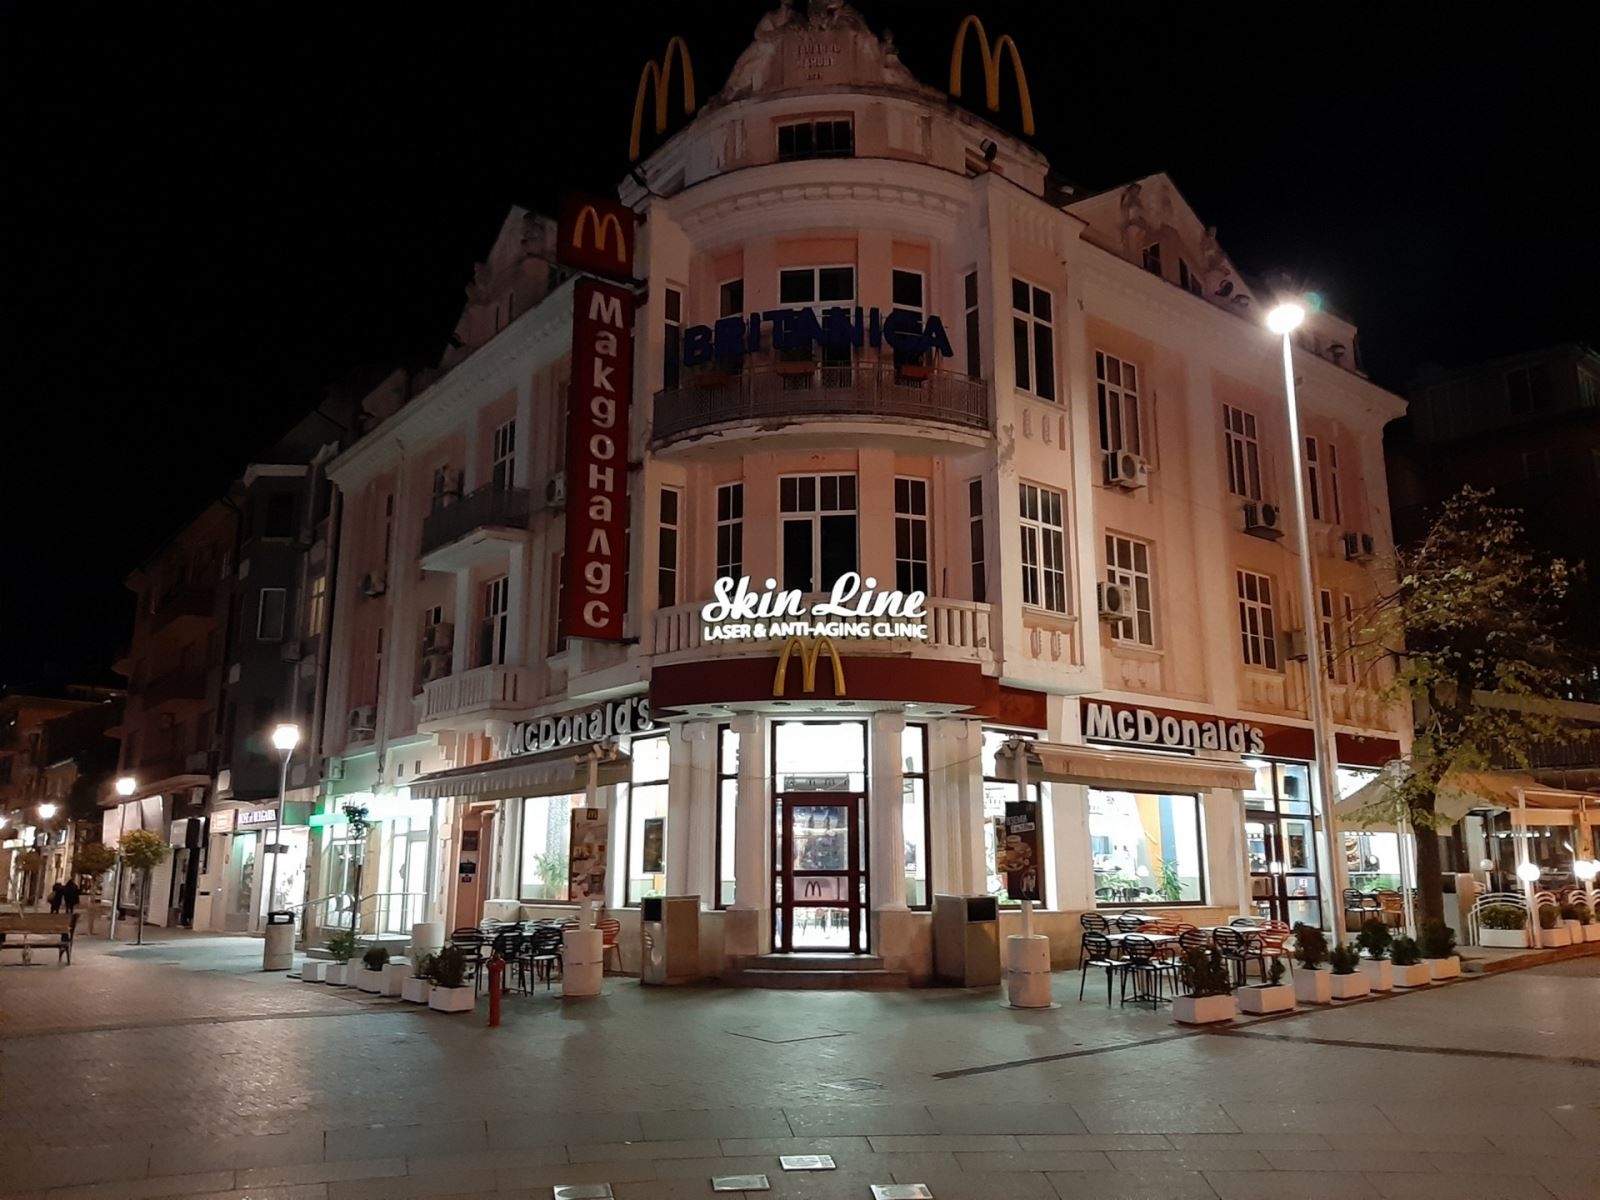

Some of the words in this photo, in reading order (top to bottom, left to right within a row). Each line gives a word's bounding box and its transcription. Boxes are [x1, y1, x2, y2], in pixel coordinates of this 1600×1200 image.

[701, 575, 806, 622] Skin
[811, 571, 928, 618] Line
[704, 623, 751, 641] LASER
[753, 622, 766, 638] &
[769, 621, 870, 638] ANTI-AGING
[873, 622, 928, 639] CLINIC
[504, 697, 654, 758] McDonald's
[1086, 702, 1265, 754] McDonald's
